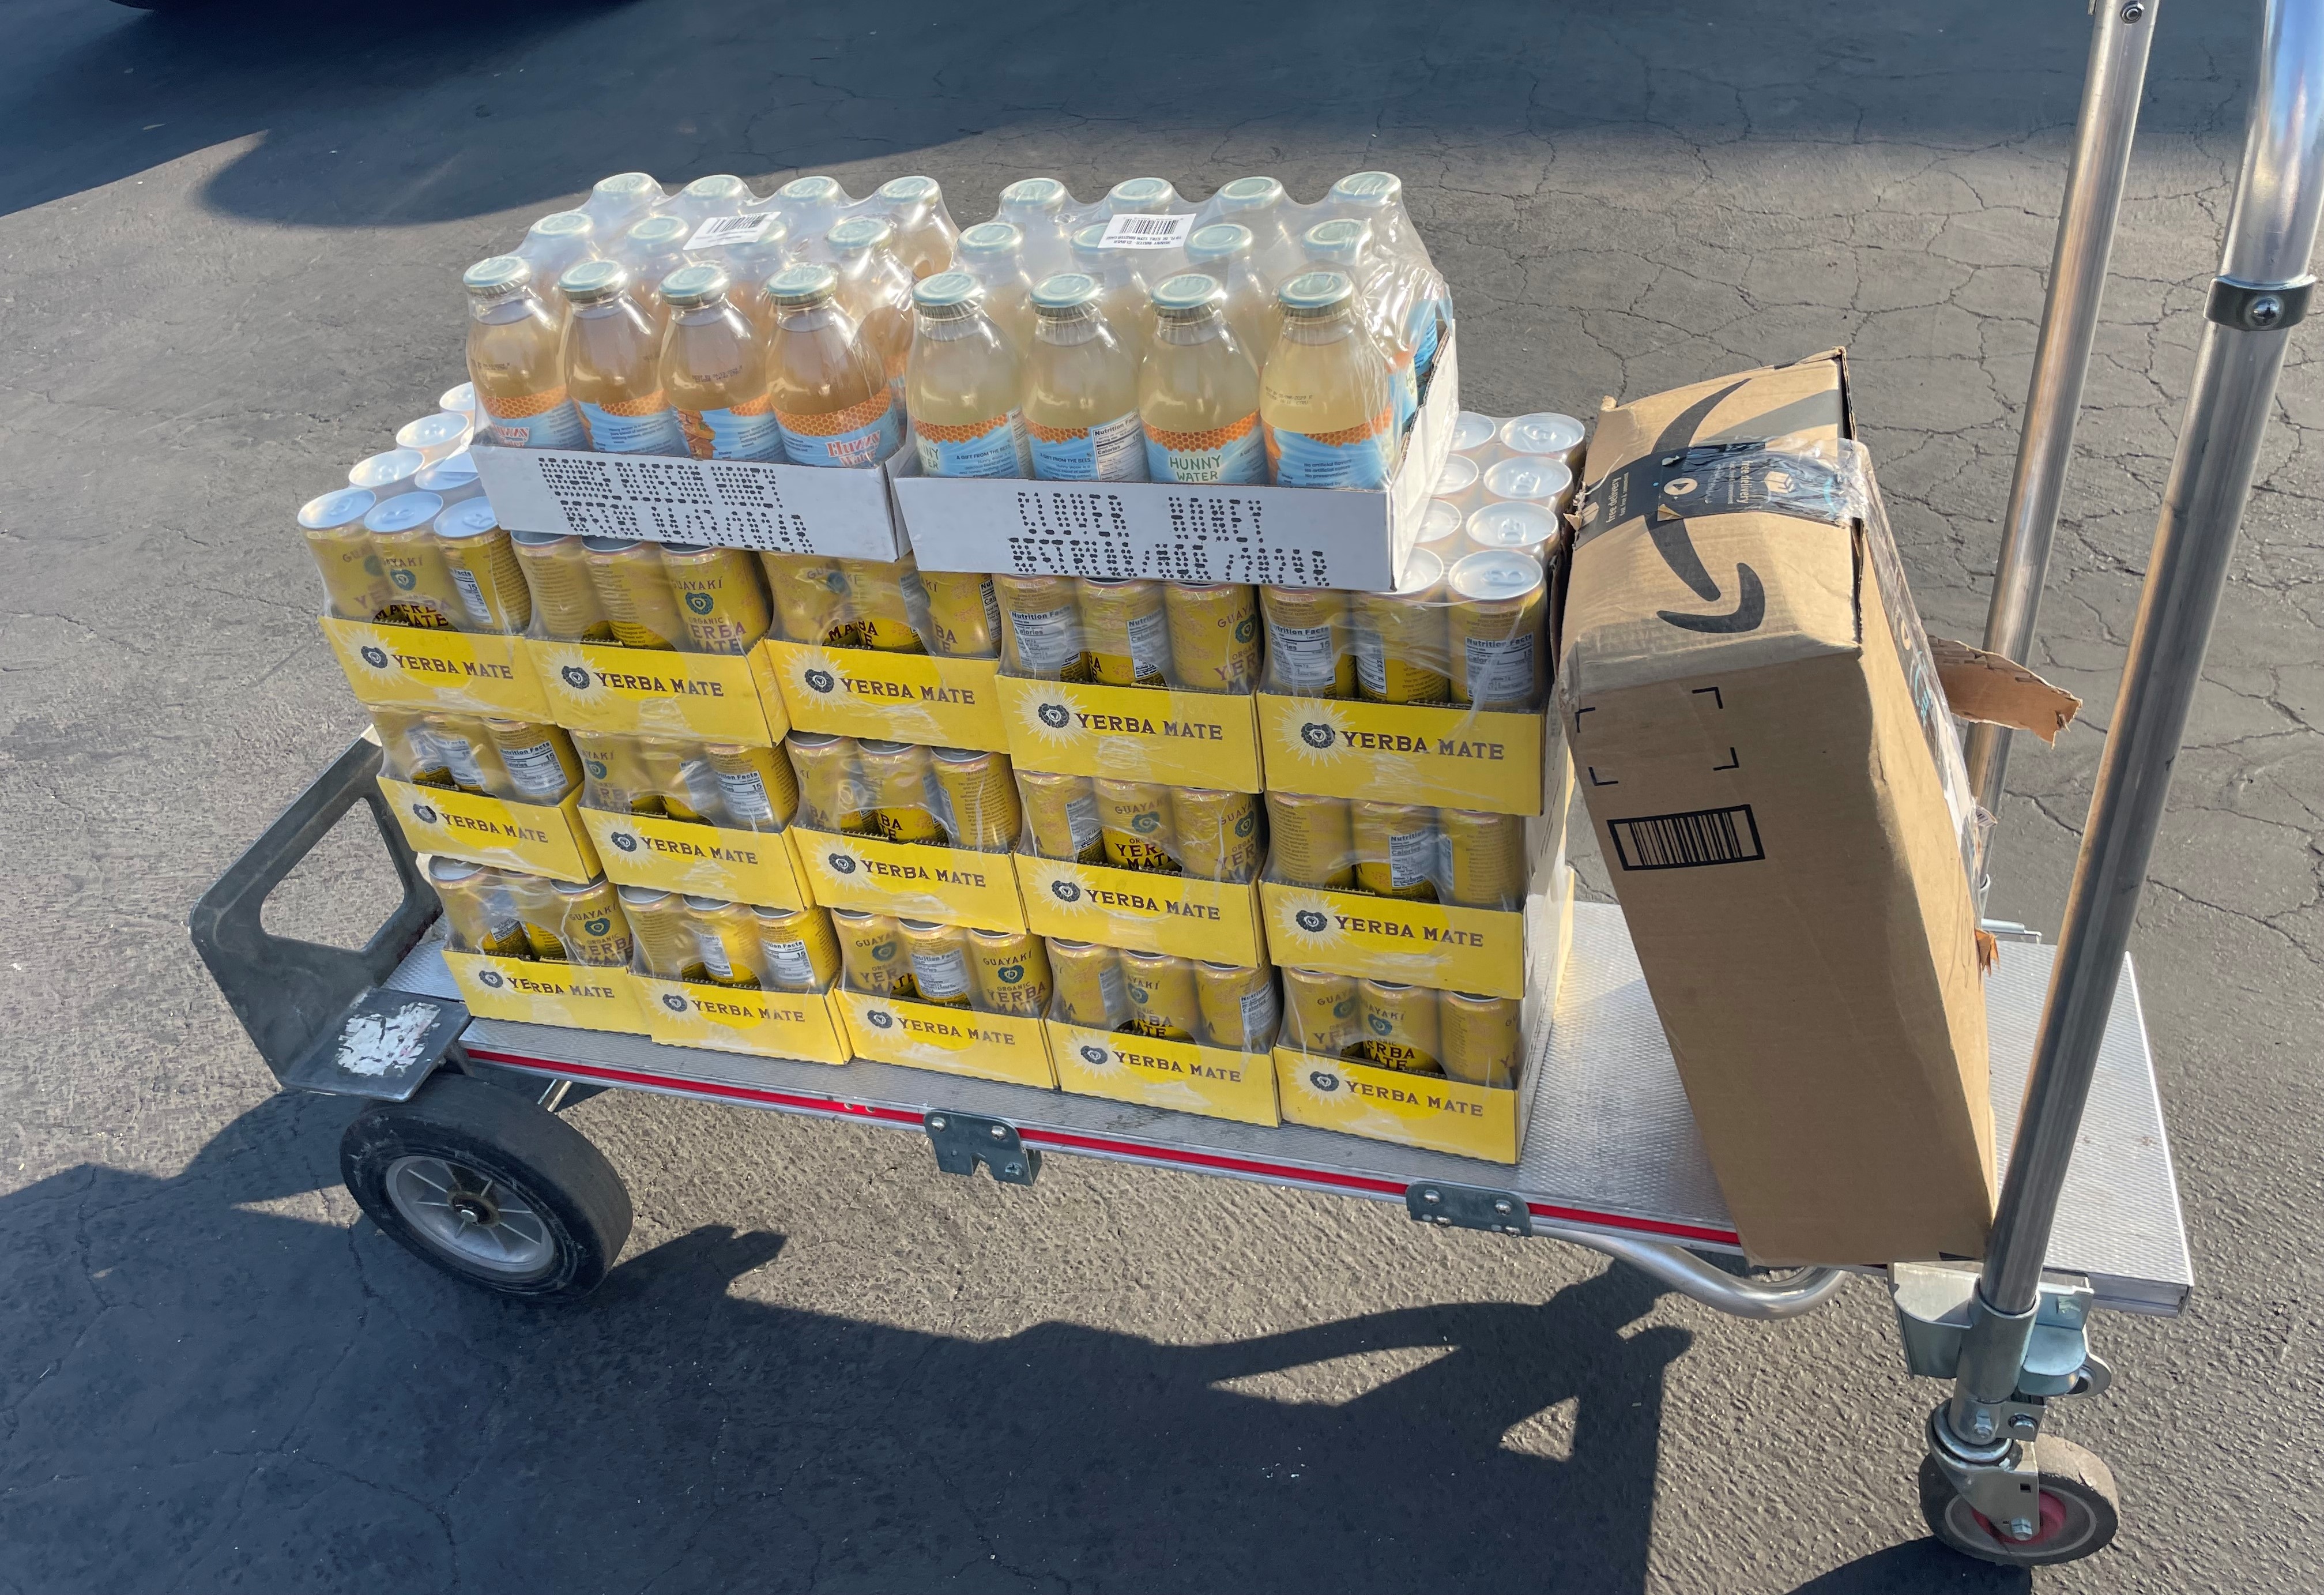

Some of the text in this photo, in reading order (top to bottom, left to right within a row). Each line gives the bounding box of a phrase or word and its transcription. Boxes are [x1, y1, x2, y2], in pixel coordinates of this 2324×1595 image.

[1095, 423, 1124, 436] Nutrition
[1098, 445, 1121, 455] Calories
[1169, 454, 1222, 471] HUNNY
[1176, 471, 1219, 483] WATER
[1736, 475, 1753, 503] delivery
[1017, 491, 1264, 543] CLOVER HONEY
[1011, 611, 1048, 620] Nutrition
[690, 621, 747, 639] ERBA
[391, 654, 514, 679] YERBA MATE
[594, 672, 724, 697] YERBA MATE
[838, 678, 975, 705] YERBA MATE
[1075, 713, 1223, 740] YERBA MATE
[1340, 731, 1504, 760] YERBA MATE
[752, 783, 763, 791] 15
[440, 812, 548, 843] YERBA MATE
[641, 837, 758, 864] YERBA MATE
[860, 859, 986, 887] YERBA MATE
[1084, 890, 1220, 921] YERBA MATE
[1334, 915, 1483, 947] YERBA MATE
[506, 977, 615, 998] YERBA MATE
[986, 981, 1047, 1003] YERBA
[997, 981, 1031, 991] ORGANIC
[691, 999, 805, 1022] YERBA MATE
[897, 1017, 1015, 1045] YERBA MATE
[1112, 1051, 1241, 1082] YERBA MATE
[1344, 1081, 1483, 1117] YERBA MATE
